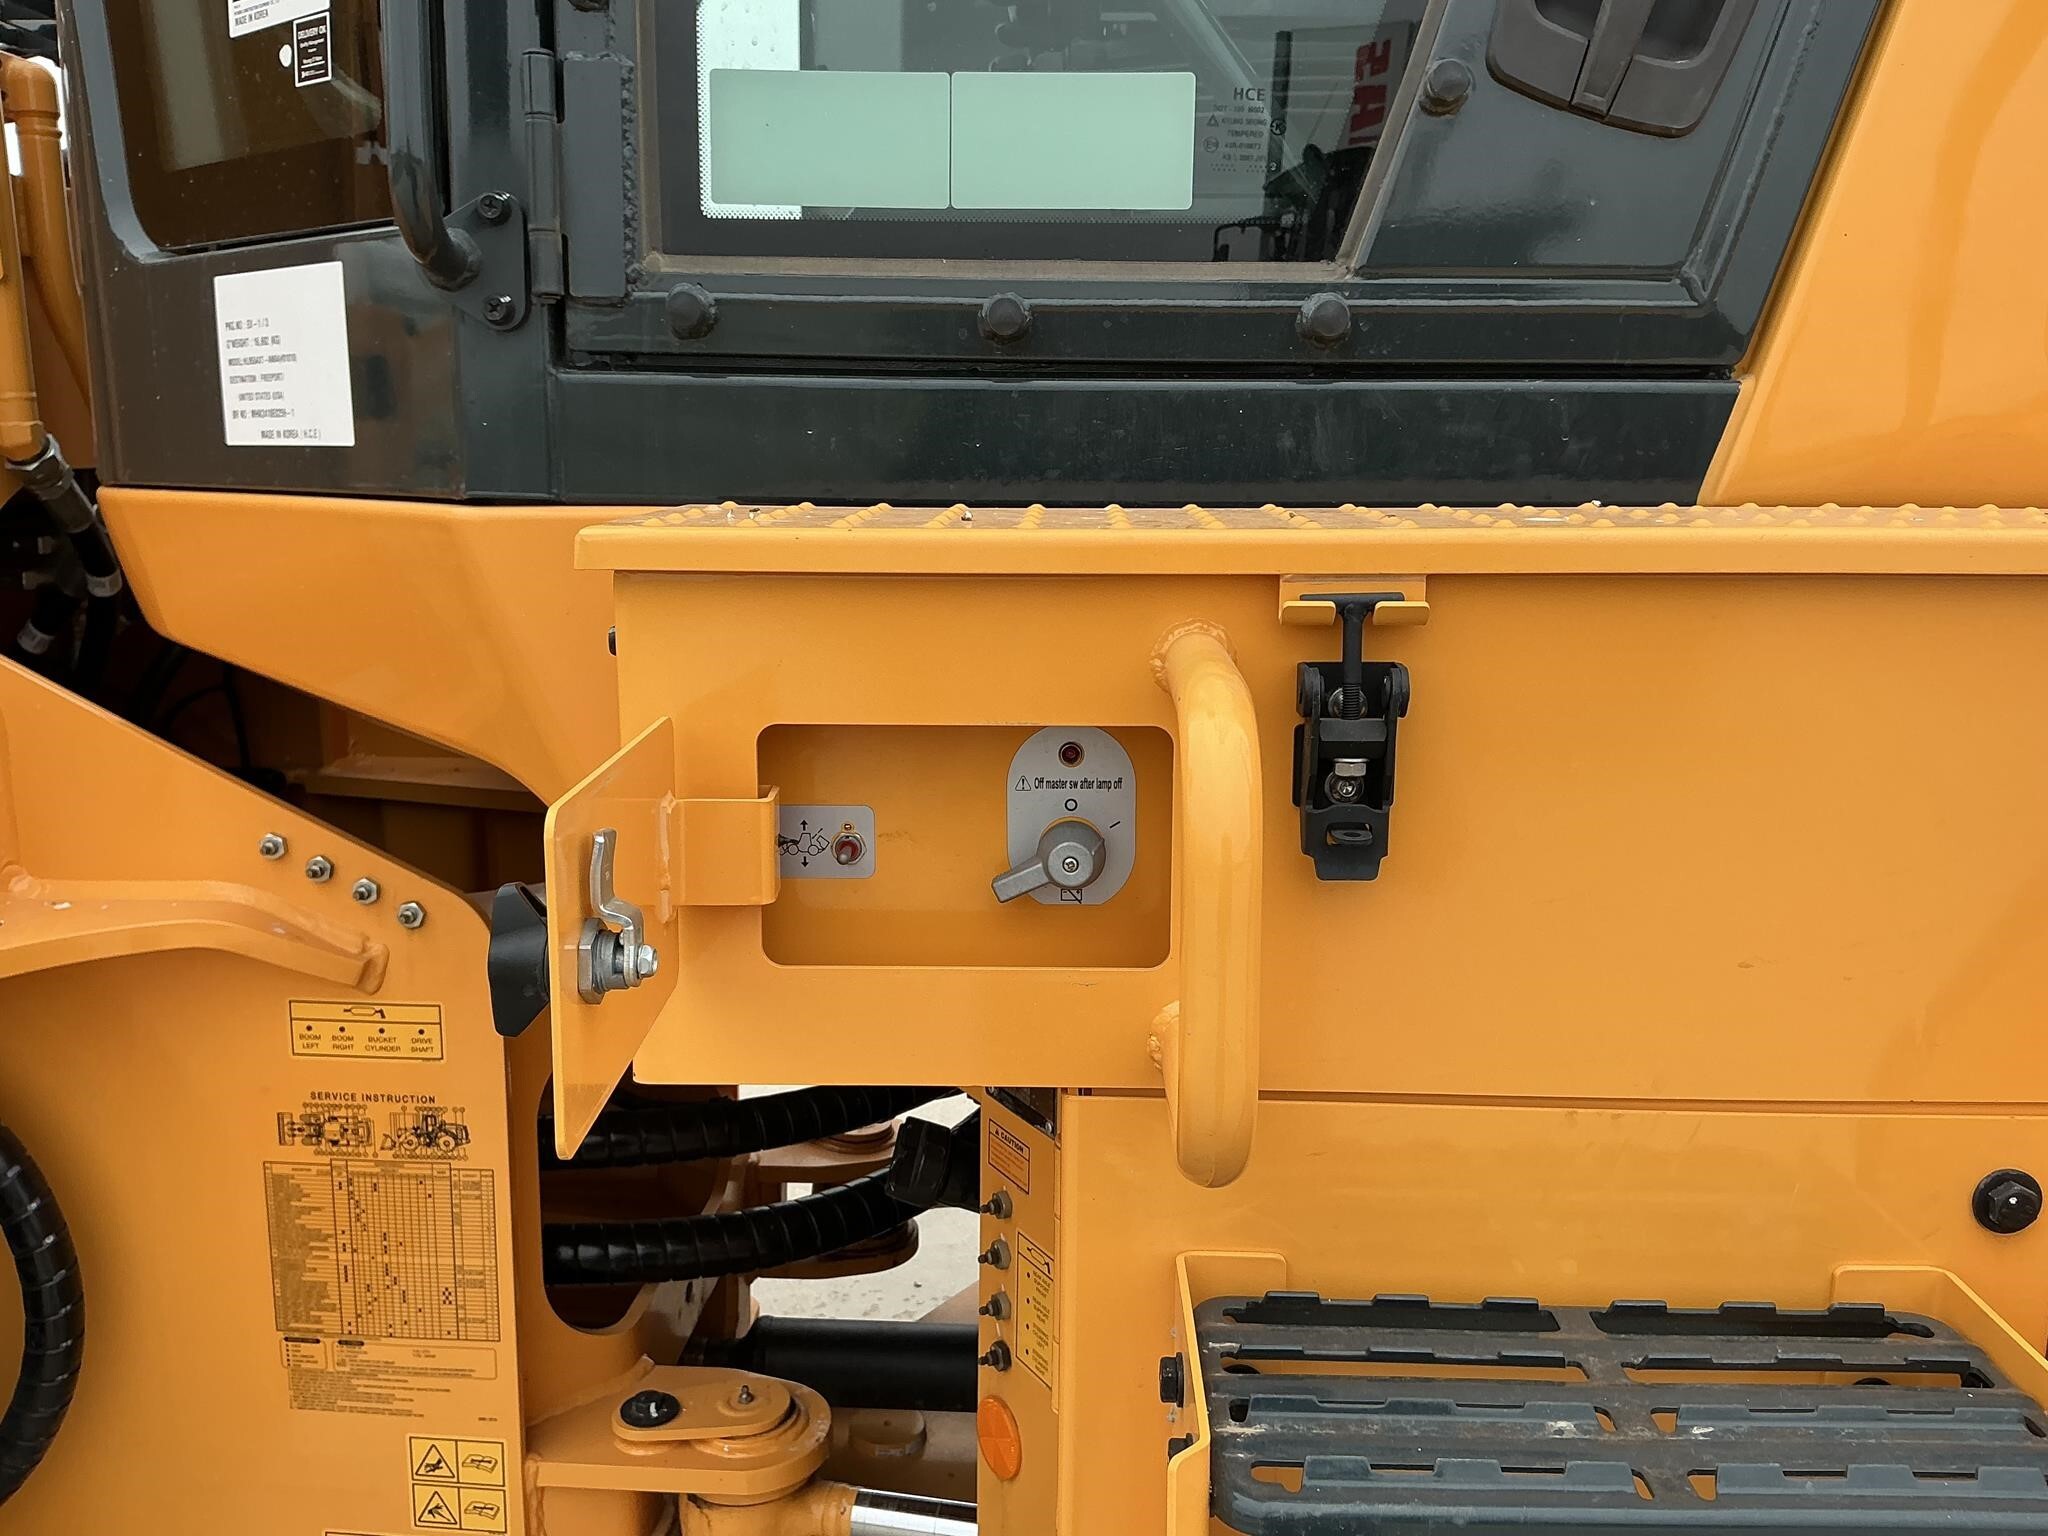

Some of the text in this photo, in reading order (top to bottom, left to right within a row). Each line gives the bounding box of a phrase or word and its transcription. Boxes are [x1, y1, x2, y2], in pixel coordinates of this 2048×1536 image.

[1233, 88, 1266, 101] HCE
[1034, 777, 1123, 792] Off master sw after lamp off
[299, 1033, 321, 1041] BOOM
[365, 1044, 401, 1052] CYLINDER
[310, 1091, 436, 1105] SERVICE INSTRUCTION
[1000, 1131, 1024, 1154] CAUTION
